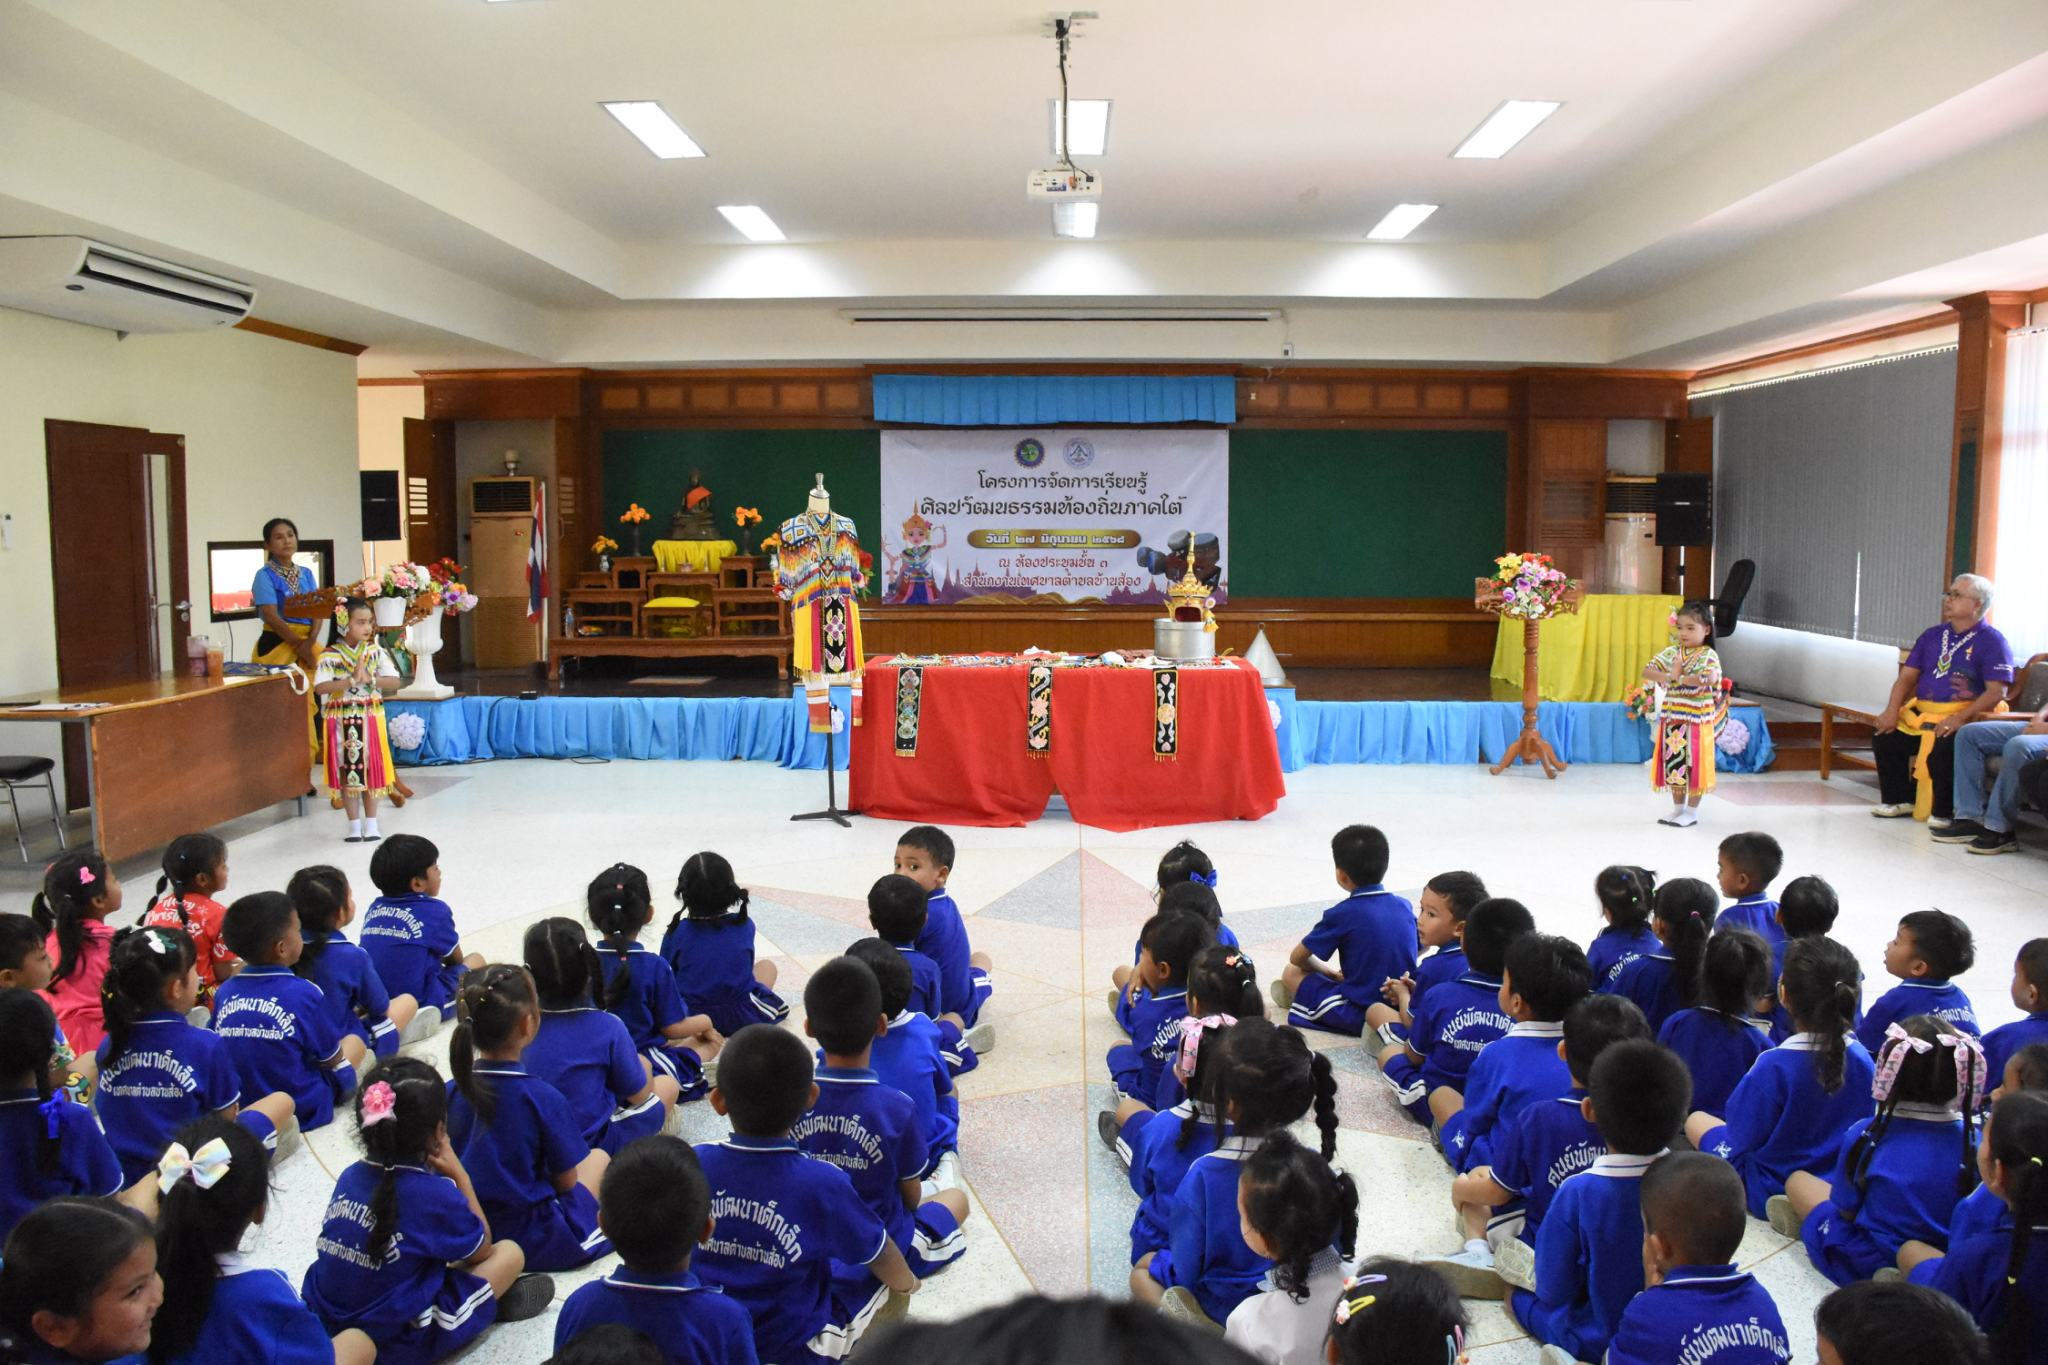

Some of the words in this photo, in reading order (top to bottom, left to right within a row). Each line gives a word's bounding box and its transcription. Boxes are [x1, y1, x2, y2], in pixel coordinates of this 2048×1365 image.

[978, 470, 1148, 495] โครงการจัดการเรียนรู้
[920, 489, 1187, 516] ศิลปวัฒนธรรมท้องถิ่นภาคใต้
[985, 531, 1010, 544] วันที่
[1040, 532, 1088, 548] มิถุนายน
[998, 557, 1010, 568] ณ
[1015, 550, 1095, 572] ห้องประชุมชั้น
